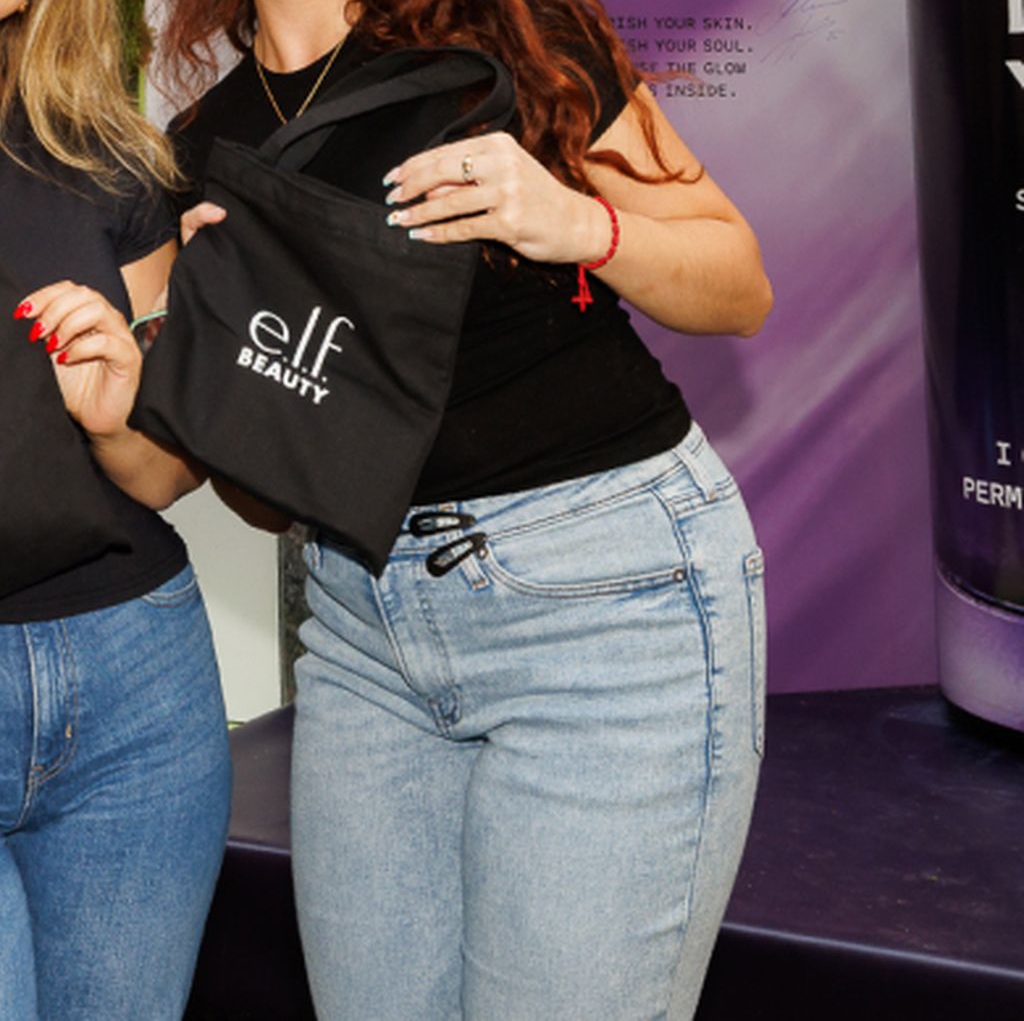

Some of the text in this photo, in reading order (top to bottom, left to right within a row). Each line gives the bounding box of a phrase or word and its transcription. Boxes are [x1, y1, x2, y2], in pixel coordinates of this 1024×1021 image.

[653, 17, 696, 30] YOUR
[702, 17, 753, 30] SKIN.
[655, 39, 697, 53] YOUR
[702, 39, 753, 53] SOUL.
[666, 62, 696, 74] THE
[703, 62, 747, 75] GLOW
[666, 83, 737, 97] INSIDE.
[236, 345, 330, 405] BEAUTY
[962, 476, 1024, 510] PERM
